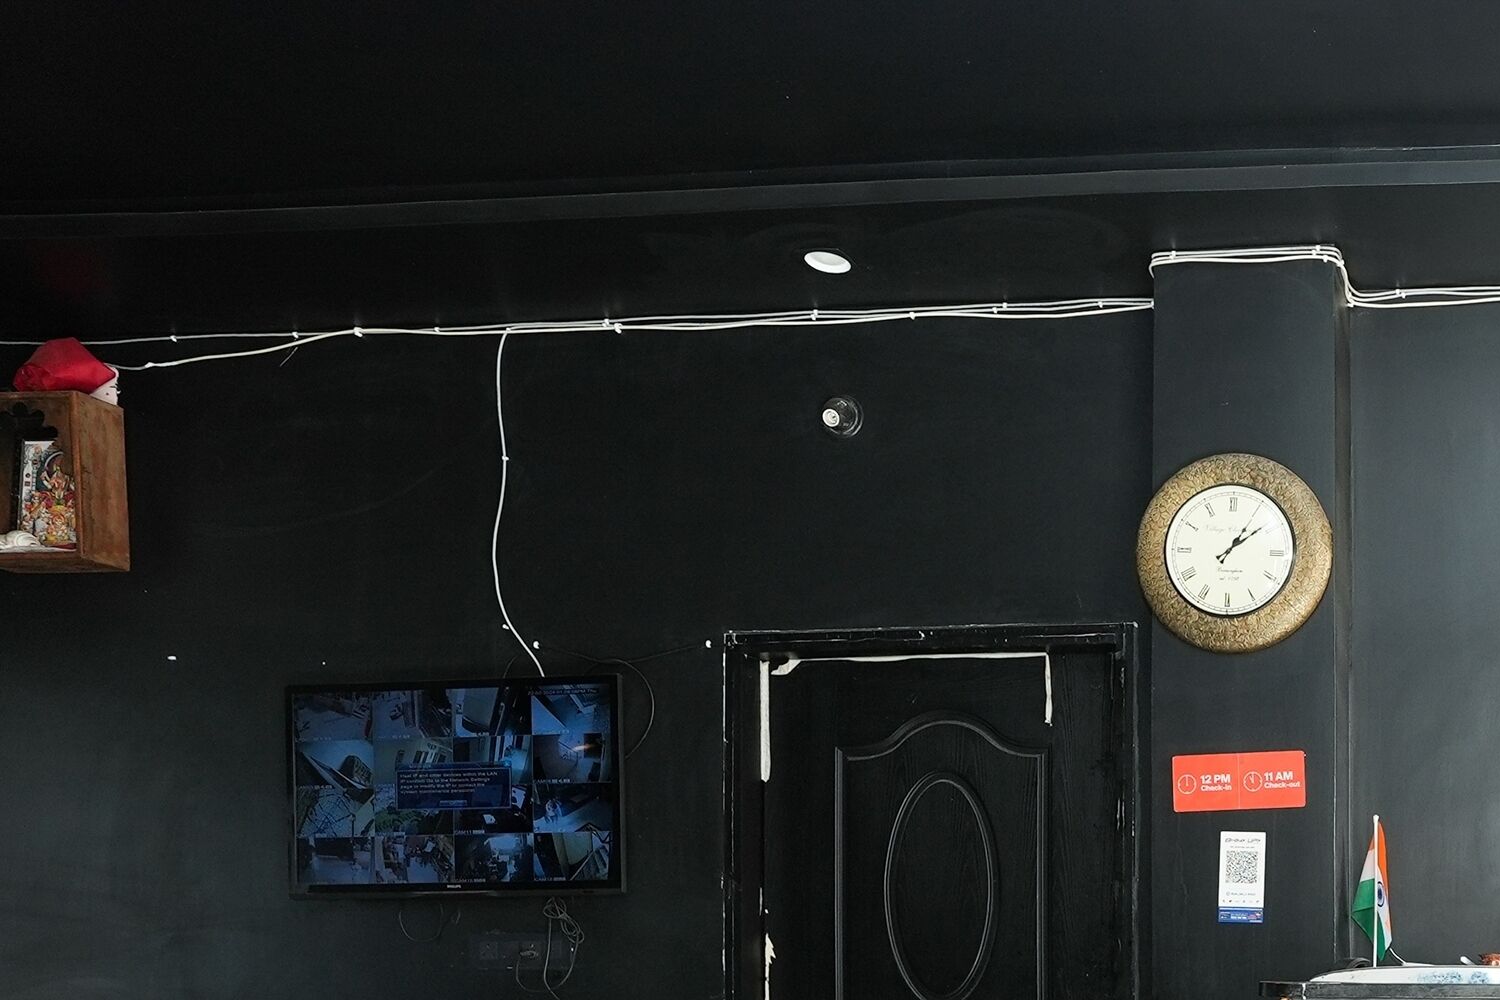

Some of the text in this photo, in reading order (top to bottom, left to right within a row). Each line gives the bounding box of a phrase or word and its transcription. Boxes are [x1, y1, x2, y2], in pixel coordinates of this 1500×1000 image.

[1200, 773, 1231, 784] 12 PM
[1264, 771, 1293, 781] 11 AM
[1200, 784, 1232, 792] Check-in
[1263, 781, 1301, 789] Check-out
